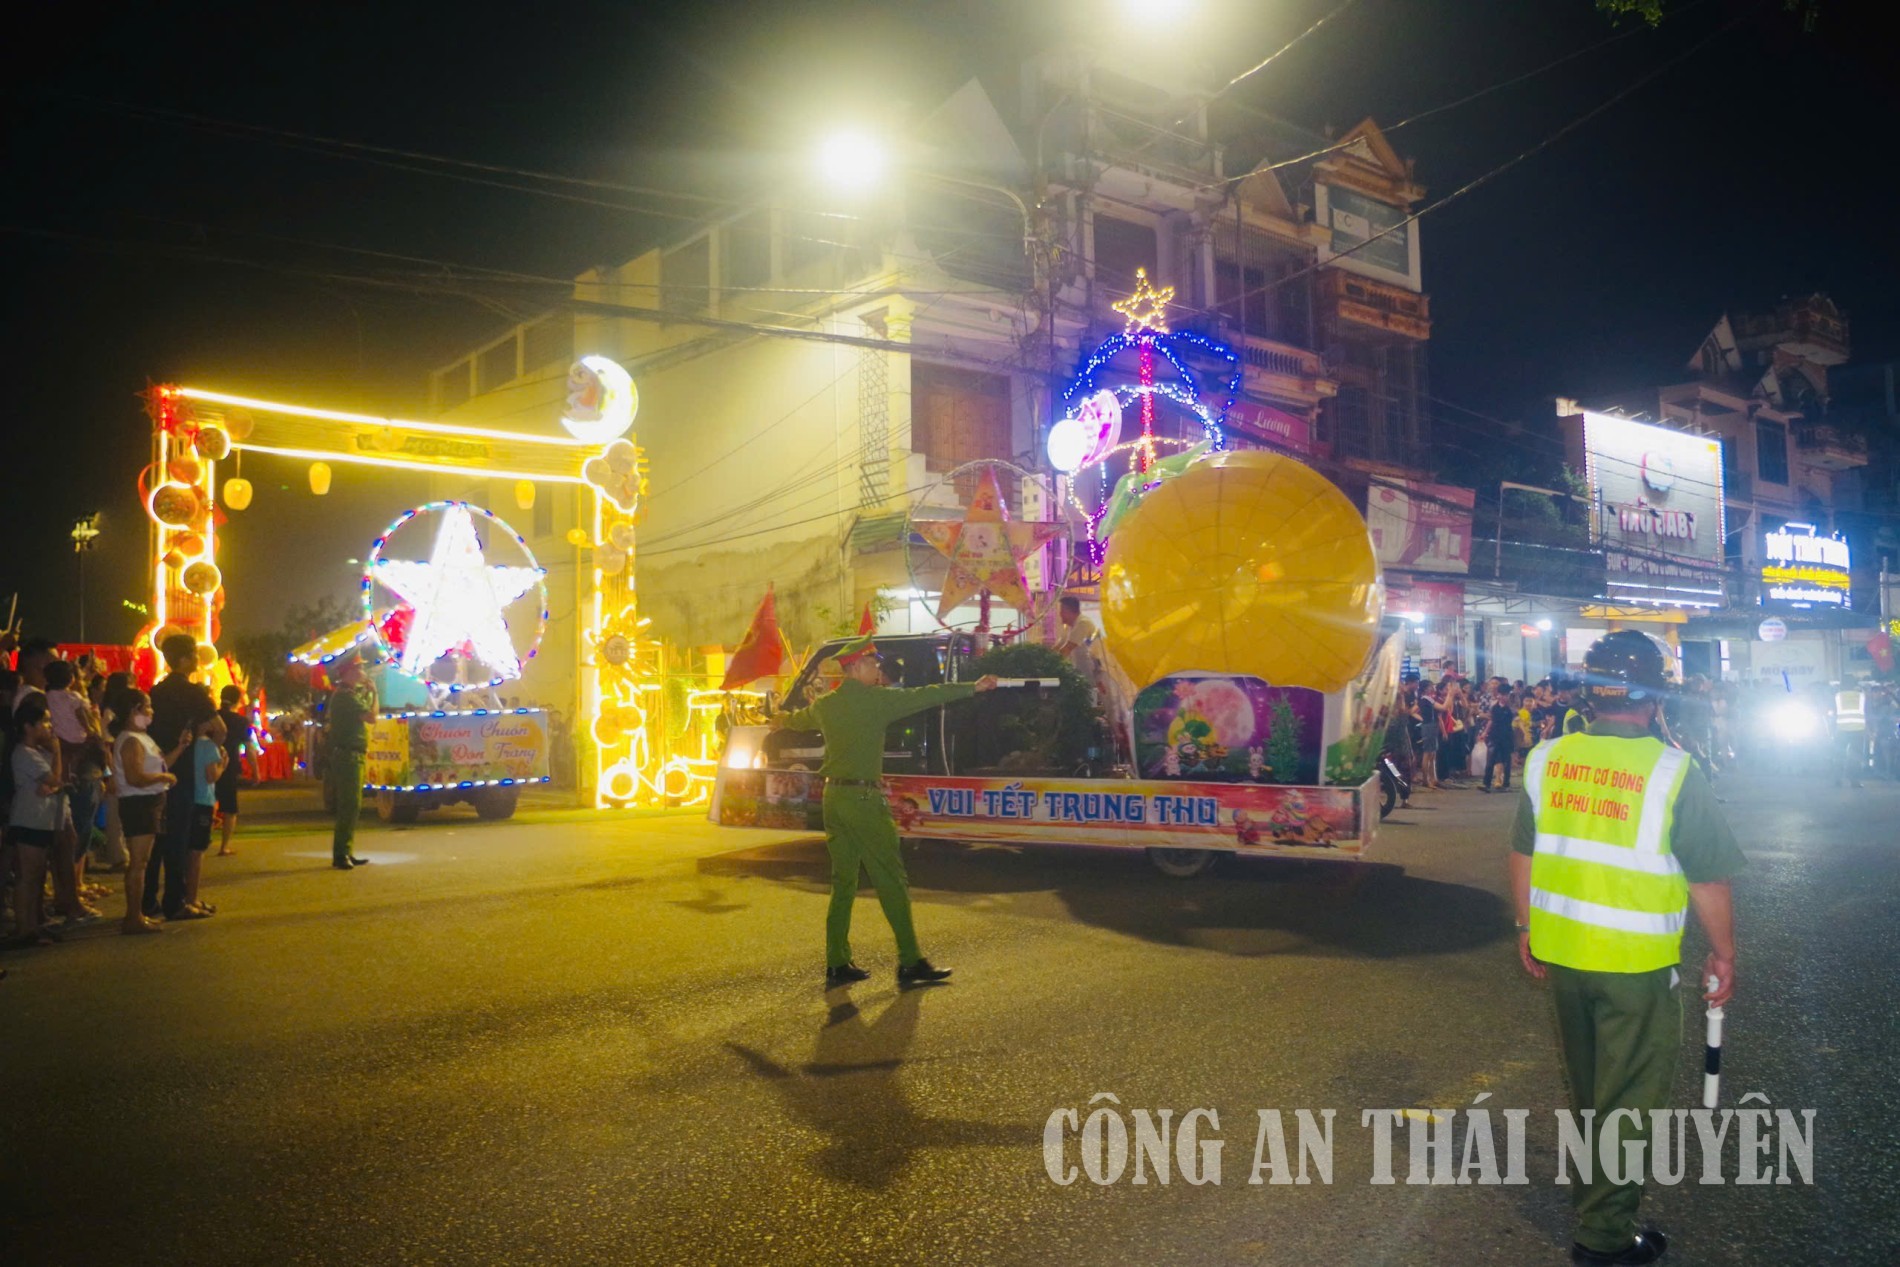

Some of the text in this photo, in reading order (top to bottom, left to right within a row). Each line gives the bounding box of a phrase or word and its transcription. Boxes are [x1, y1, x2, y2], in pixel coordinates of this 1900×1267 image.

[1546, 758, 1645, 794] TỔ ANTT CƠ ĐỘNG
[926, 781, 1219, 828] VUI TẾT TRUNG THU
[1550, 789, 1630, 822] XÃ PHÚ LƯƠNG
